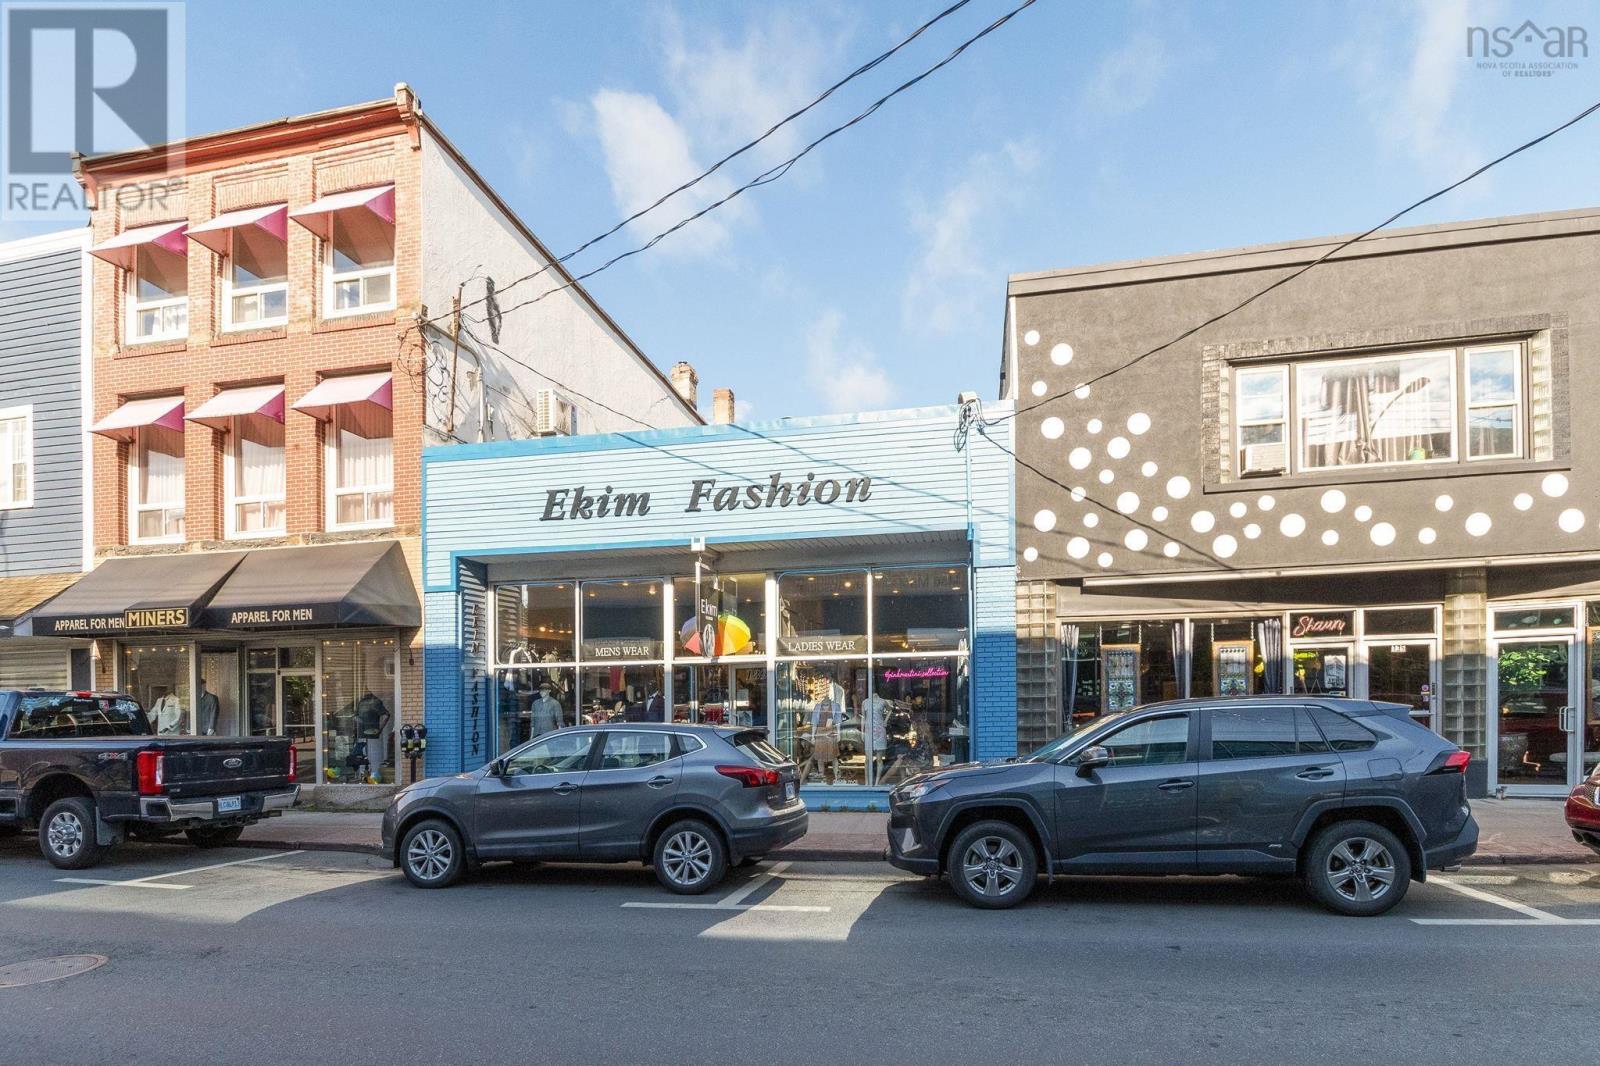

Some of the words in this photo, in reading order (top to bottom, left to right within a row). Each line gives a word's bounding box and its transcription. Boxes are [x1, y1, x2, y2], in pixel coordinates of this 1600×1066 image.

[539, 485, 651, 521] Ekim
[685, 472, 872, 512] Fashion
[54, 619, 89, 631] APPAREL
[90, 618, 107, 630] FOR
[108, 617, 125, 629] MEN
[128, 609, 185, 627] MINERS
[231, 610, 270, 624] APPAREL
[272, 609, 291, 622] FOR
[292, 608, 313, 621] MEN
[595, 647, 621, 657] MENS
[622, 646, 649, 656] WEAR
[788, 641, 823, 652] LADIES
[825, 640, 856, 650] WEAR
[470, 668, 480, 756] FASHION
